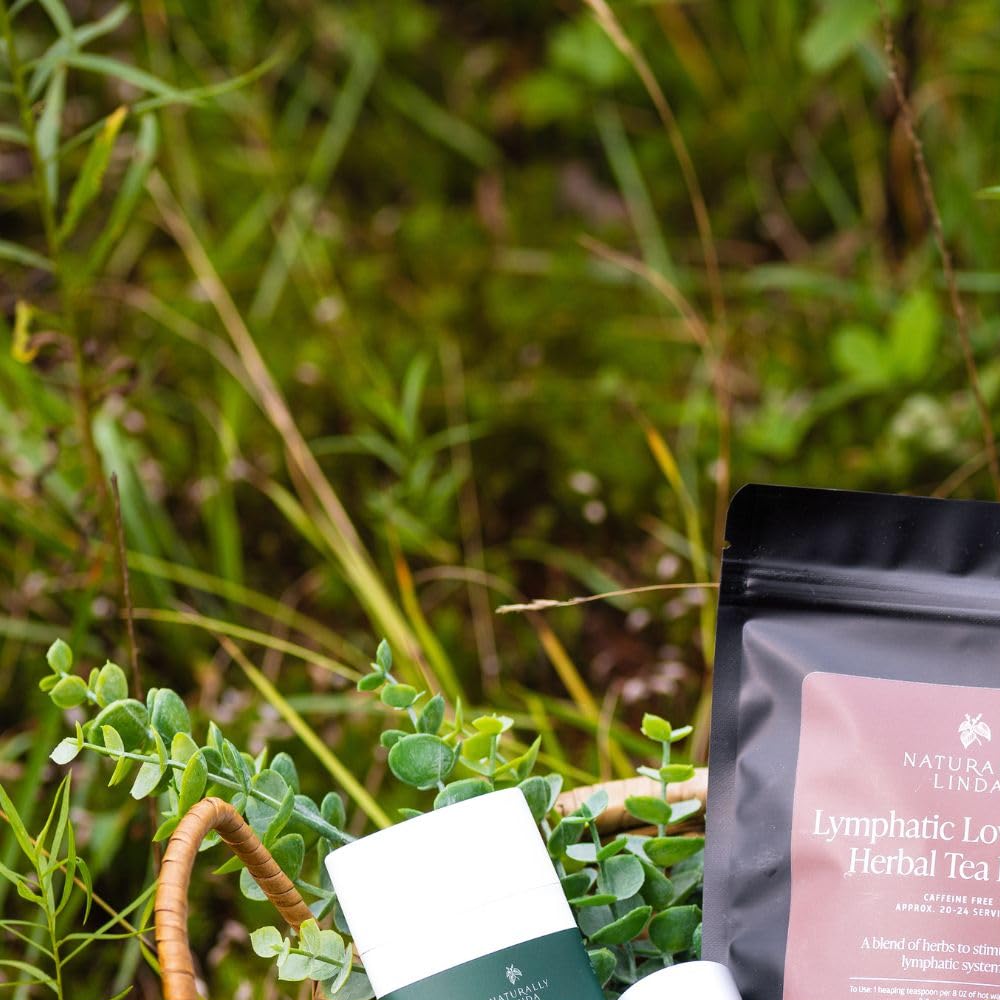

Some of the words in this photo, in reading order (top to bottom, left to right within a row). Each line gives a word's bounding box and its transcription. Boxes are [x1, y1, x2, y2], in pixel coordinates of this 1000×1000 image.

[813, 809, 954, 844] Lymphatic
[848, 848, 936, 877] Herbal
[944, 852, 990, 881] Tea
[924, 893, 967, 905] CAFFEINE
[971, 897, 994, 906] FREE
[895, 903, 935, 914] APPROX.
[940, 906, 969, 916] 20-24
[860, 937, 872, 949] A
[872, 936, 905, 950] blend
[907, 939, 922, 951] of
[922, 939, 954, 952] herbs
[957, 944, 970, 954] to
[901, 955, 959, 972] lymphatic
[850, 985, 858, 993] To
[878, 986, 906, 996] heaping
[906, 988, 938, 996] teaspoon
[968, 990, 977, 998] of
